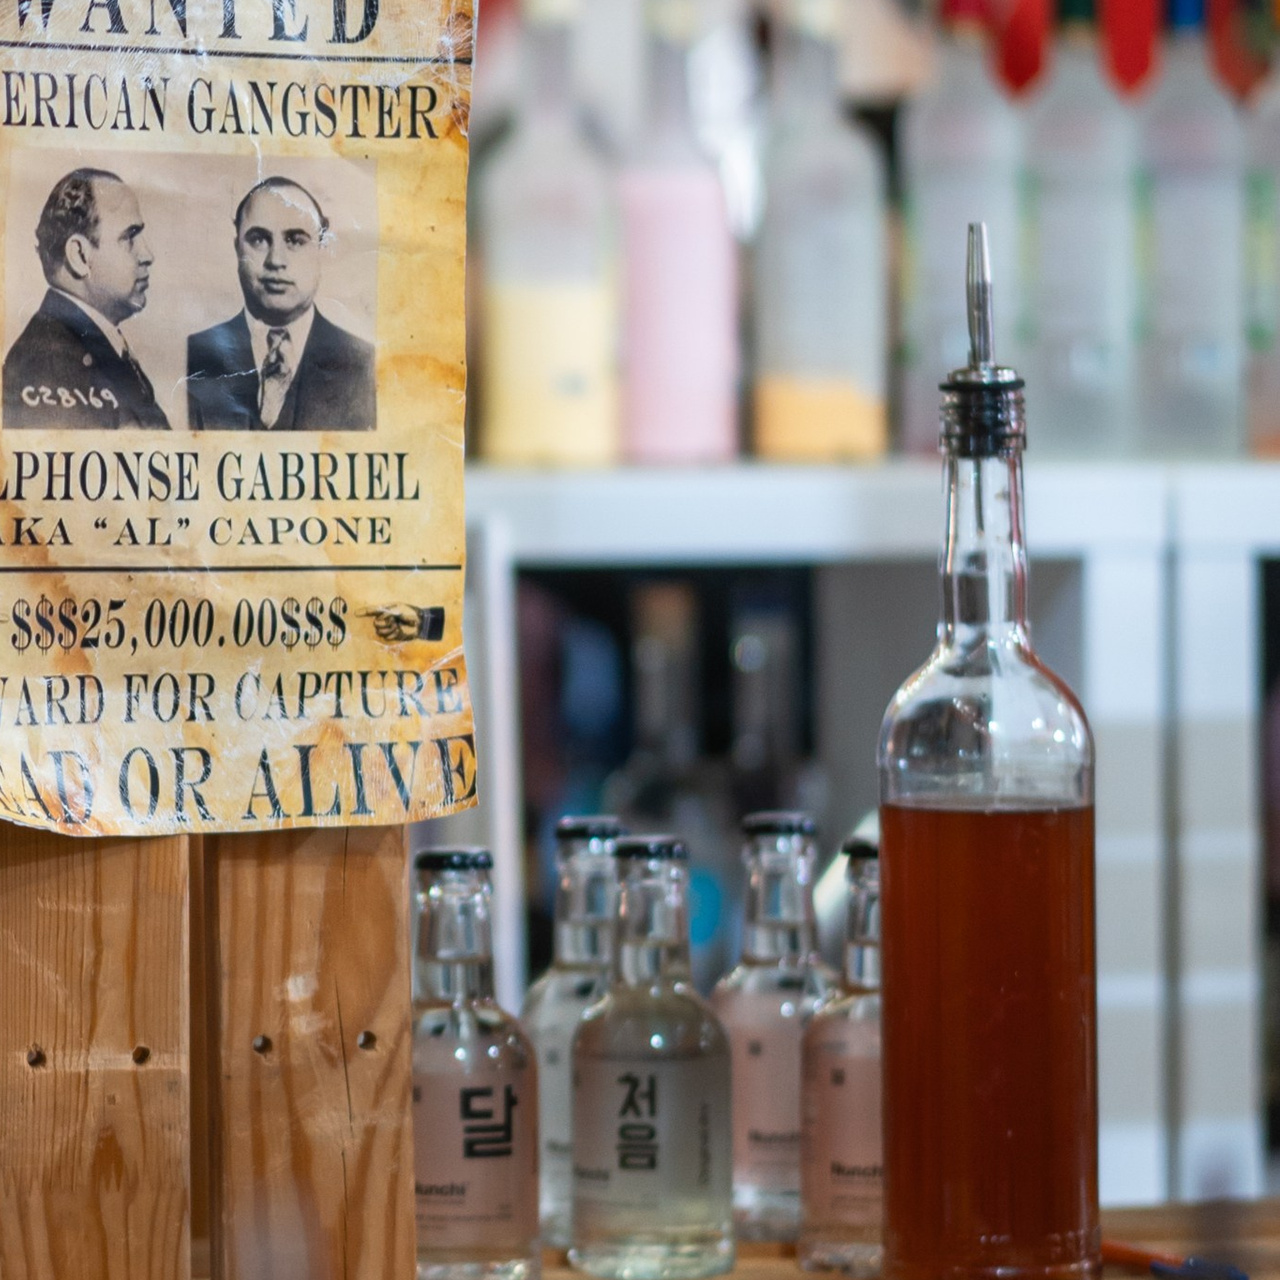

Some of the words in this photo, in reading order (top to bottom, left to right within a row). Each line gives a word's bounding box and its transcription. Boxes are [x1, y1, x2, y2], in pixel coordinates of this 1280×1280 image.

[187, 77, 440, 140] GANGSTER
[22, 385, 120, 409] C28169
[217, 451, 421, 502] GABRIEL
[209, 516, 393, 546] CAPONE
[11, 596, 349, 657] $$$25,000.00$$$
[123, 671, 216, 724] FOR
[235, 667, 464, 722] CAPTURE
[118, 746, 216, 825] OR
[241, 733, 478, 821] ALIVE
[459, 1083, 518, 1158] 달
